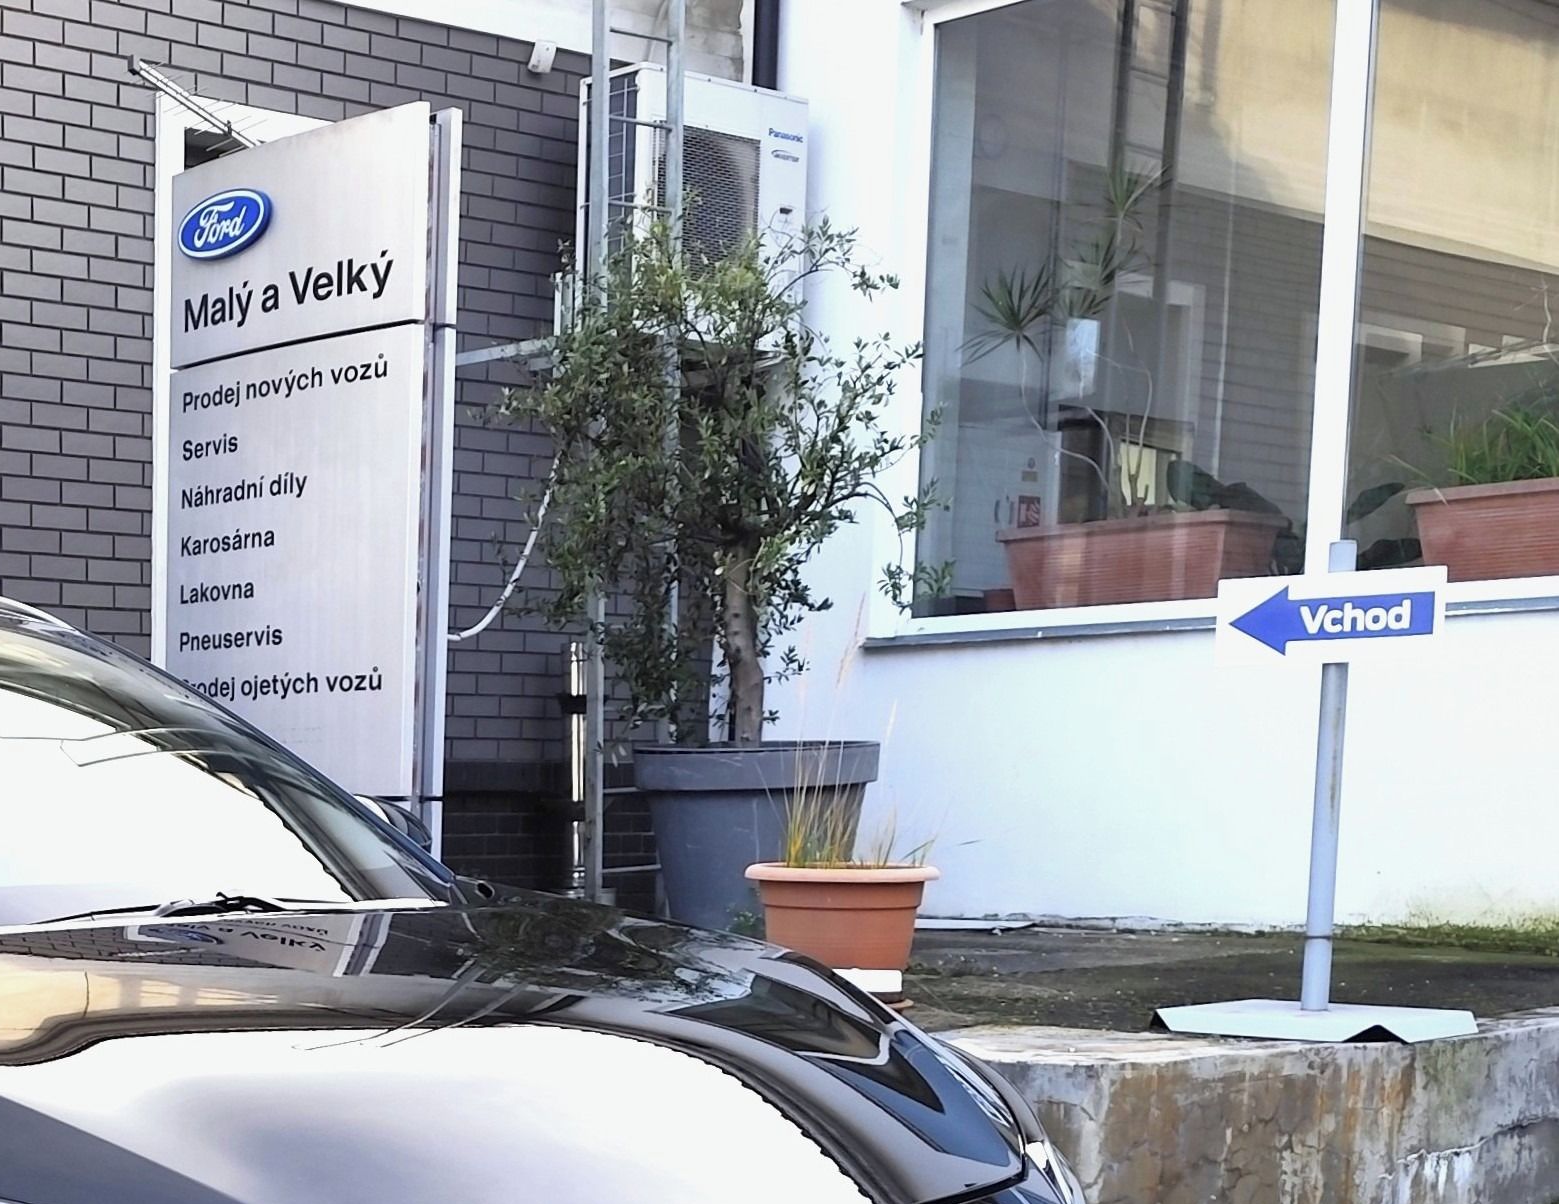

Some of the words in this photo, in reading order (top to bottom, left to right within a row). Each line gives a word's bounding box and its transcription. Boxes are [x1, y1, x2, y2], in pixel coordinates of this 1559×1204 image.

[193, 200, 248, 249] Ford
[184, 280, 254, 333] Malý
[260, 283, 280, 313] a
[288, 249, 394, 305] Velký
[182, 381, 241, 413] Prodej
[245, 366, 323, 398] nových
[330, 352, 388, 385] vozů
[182, 433, 239, 461] Servis
[181, 475, 265, 509] Náhradní
[269, 471, 308, 498] díly
[181, 528, 276, 557] Karosárna
[180, 581, 255, 605] Lakovna
[1299, 598, 1412, 634] Vchod
[179, 625, 283, 652] Pneuservis
[181, 677, 236, 702] odej
[240, 671, 319, 700] ojetých
[326, 665, 383, 692] vozů
